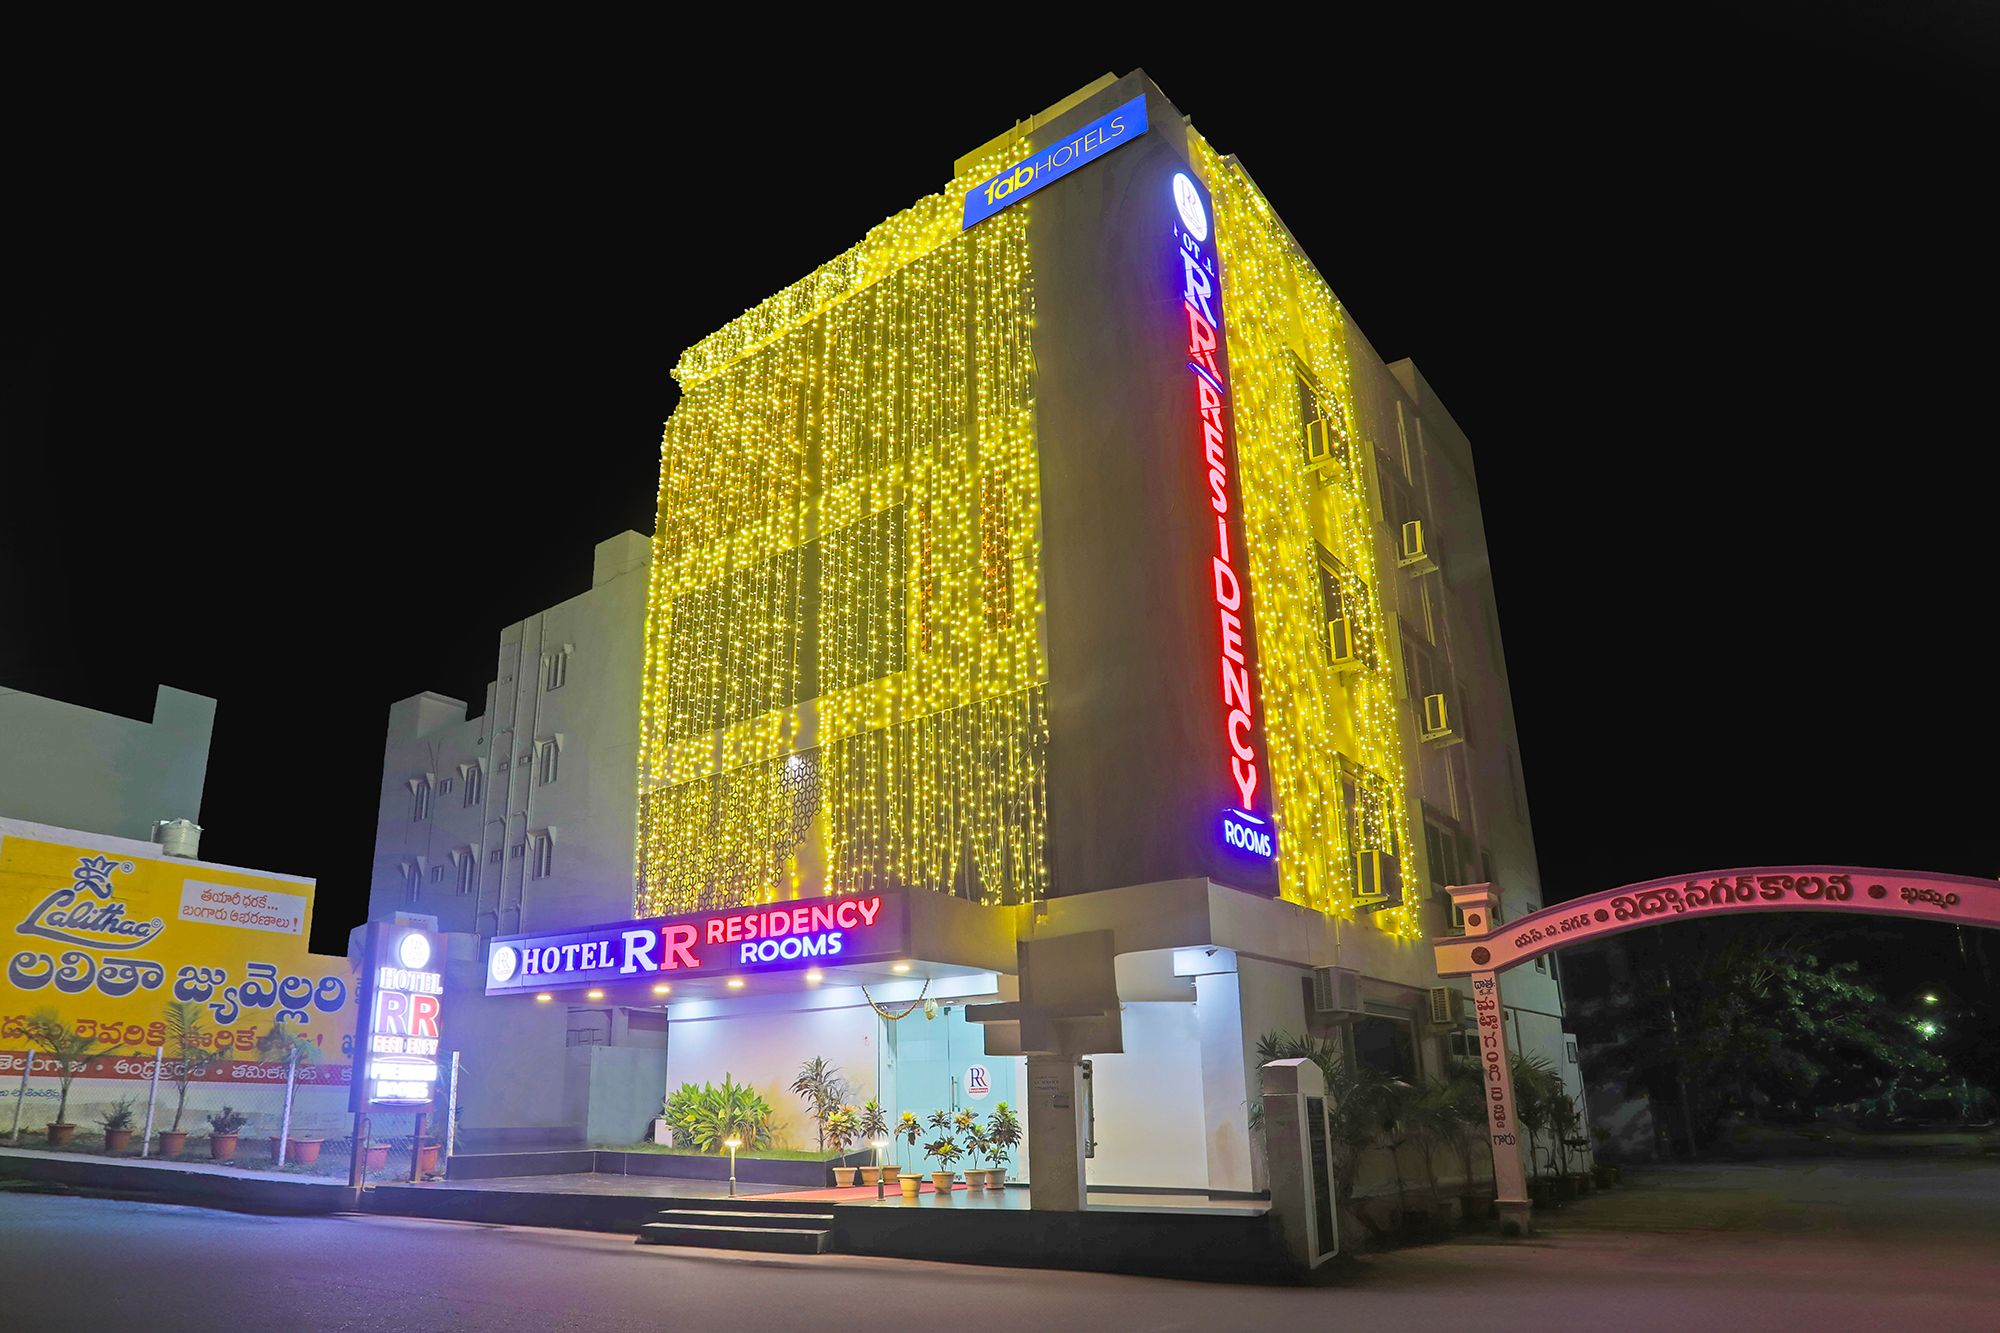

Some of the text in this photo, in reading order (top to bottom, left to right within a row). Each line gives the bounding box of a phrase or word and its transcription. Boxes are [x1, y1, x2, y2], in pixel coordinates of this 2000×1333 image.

[984, 116, 1124, 205] fabHOTELS
[1197, 374, 1257, 811] RESIDENCY
[1224, 819, 1272, 857] ROOMS
[182, 905, 228, 920] బంగారు
[1900, 887, 1959, 909] ఖమ్మం
[16, 889, 164, 949] Lalithaa
[521, 940, 614, 975] HOTEL
[707, 897, 881, 944] RESIDENCY
[740, 932, 842, 963] ROOMS
[8, 950, 165, 997] లలితా
[380, 967, 443, 995] HOTEL
[373, 1035, 438, 1055] RESIDENCY
[1493, 1132, 1516, 1146] గారు
